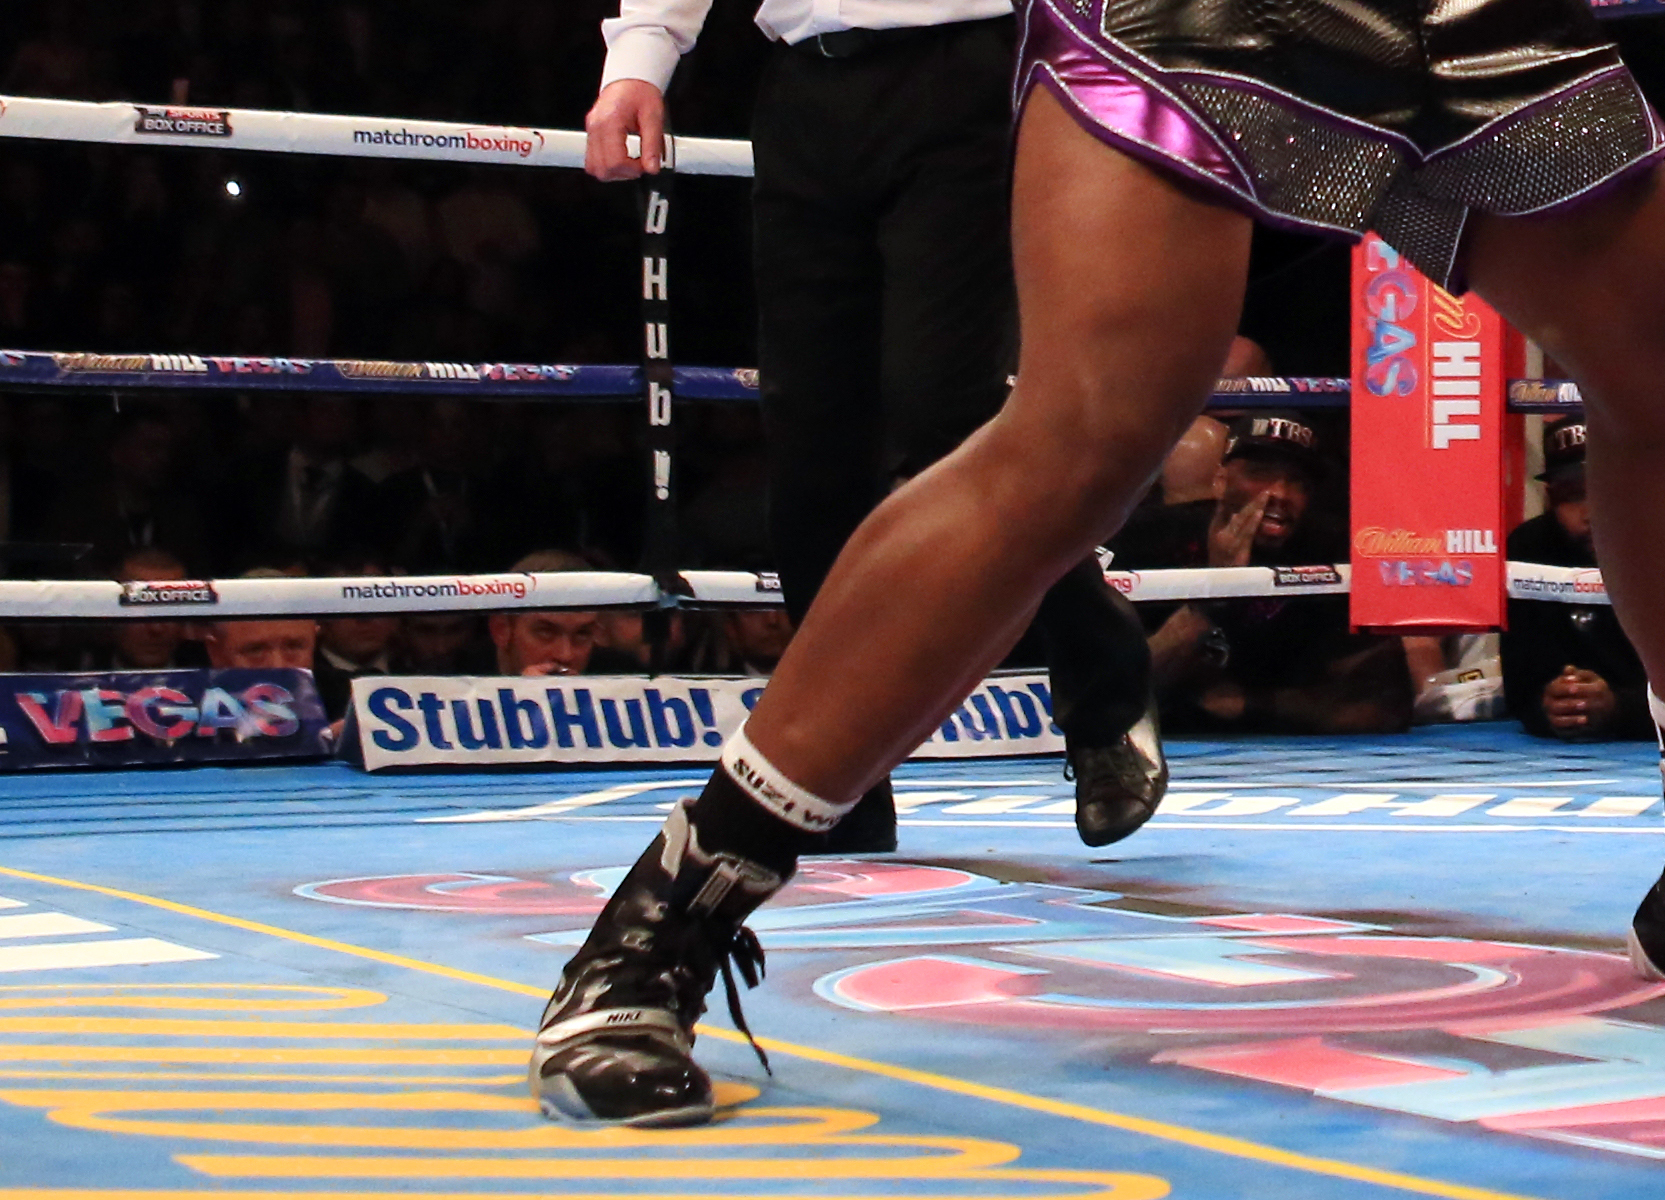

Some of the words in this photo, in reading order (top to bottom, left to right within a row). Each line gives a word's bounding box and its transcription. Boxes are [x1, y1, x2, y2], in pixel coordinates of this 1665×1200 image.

[145, 117, 174, 132] BOX
[174, 119, 225, 135] OFFICE
[353, 127, 534, 157] matchroomboxing
[150, 353, 209, 373] HILL
[424, 361, 482, 381] HILL
[1246, 376, 1291, 393] HILL
[1432, 341, 1481, 450] HILL
[1446, 529, 1498, 555] HILL
[1378, 560, 1474, 586] VEGAS
[342, 578, 527, 599] matchroomboxing
[14, 682, 300, 745] VEGAS
[366, 686, 724, 752] StubHub!
